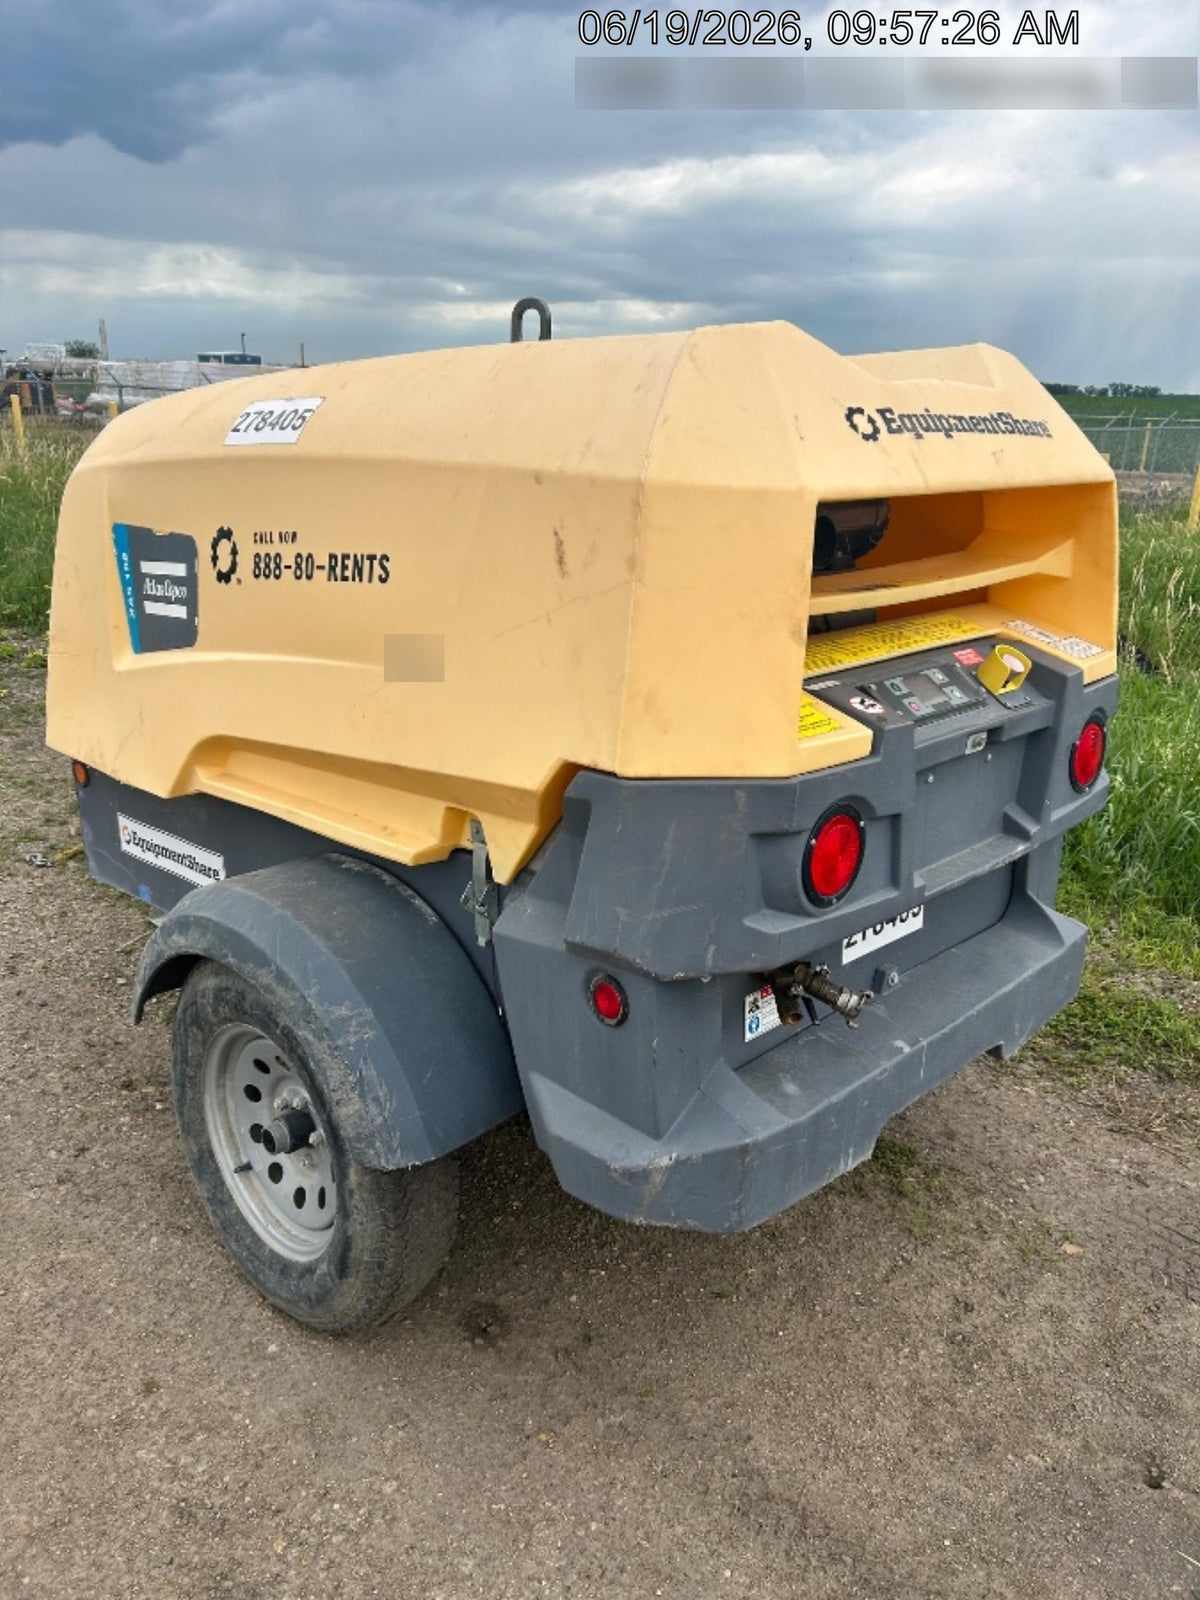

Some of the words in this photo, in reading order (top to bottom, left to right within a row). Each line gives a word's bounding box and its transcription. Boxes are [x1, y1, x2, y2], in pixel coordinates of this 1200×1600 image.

[231, 408, 315, 433] 278405
[876, 407, 1053, 439] EquipmentShare
[253, 531, 274, 544] CALL
[278, 531, 298, 544] NOW
[252, 552, 391, 584] 888-80-RENTS
[131, 830, 221, 881] EquipmentShare
